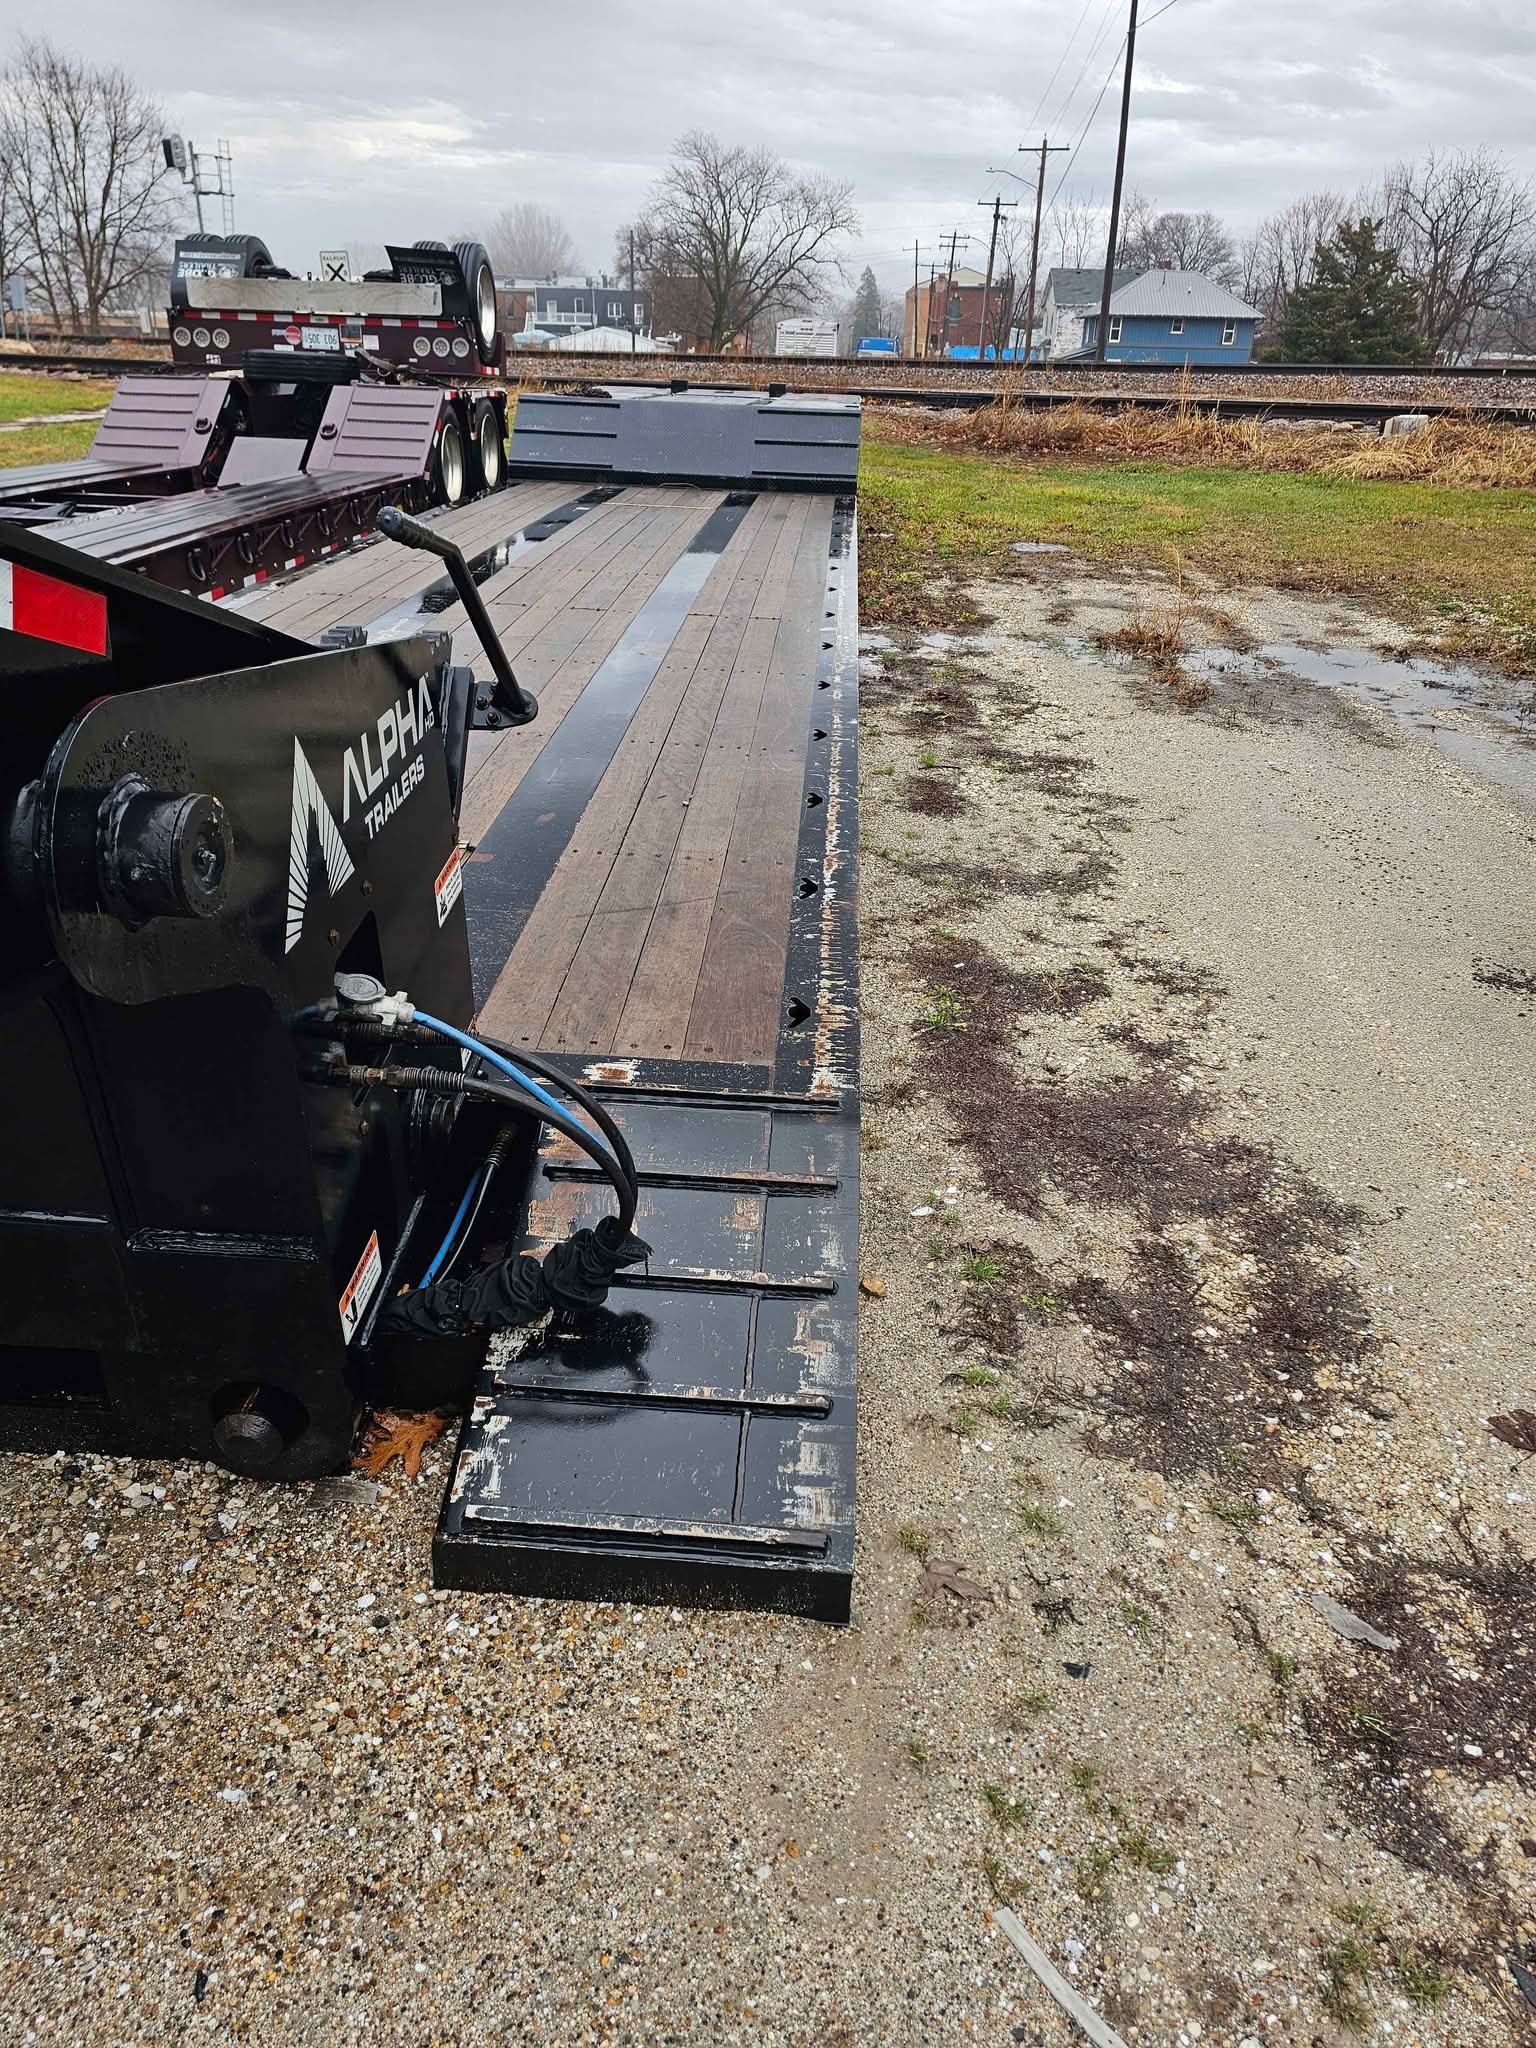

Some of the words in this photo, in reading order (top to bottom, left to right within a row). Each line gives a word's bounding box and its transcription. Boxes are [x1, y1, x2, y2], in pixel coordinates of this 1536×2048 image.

[400, 273, 438, 283] GLOBE
[424, 710, 435, 732] HD
[343, 674, 433, 824] ALPHA
[364, 753, 425, 840] TRAILERS
